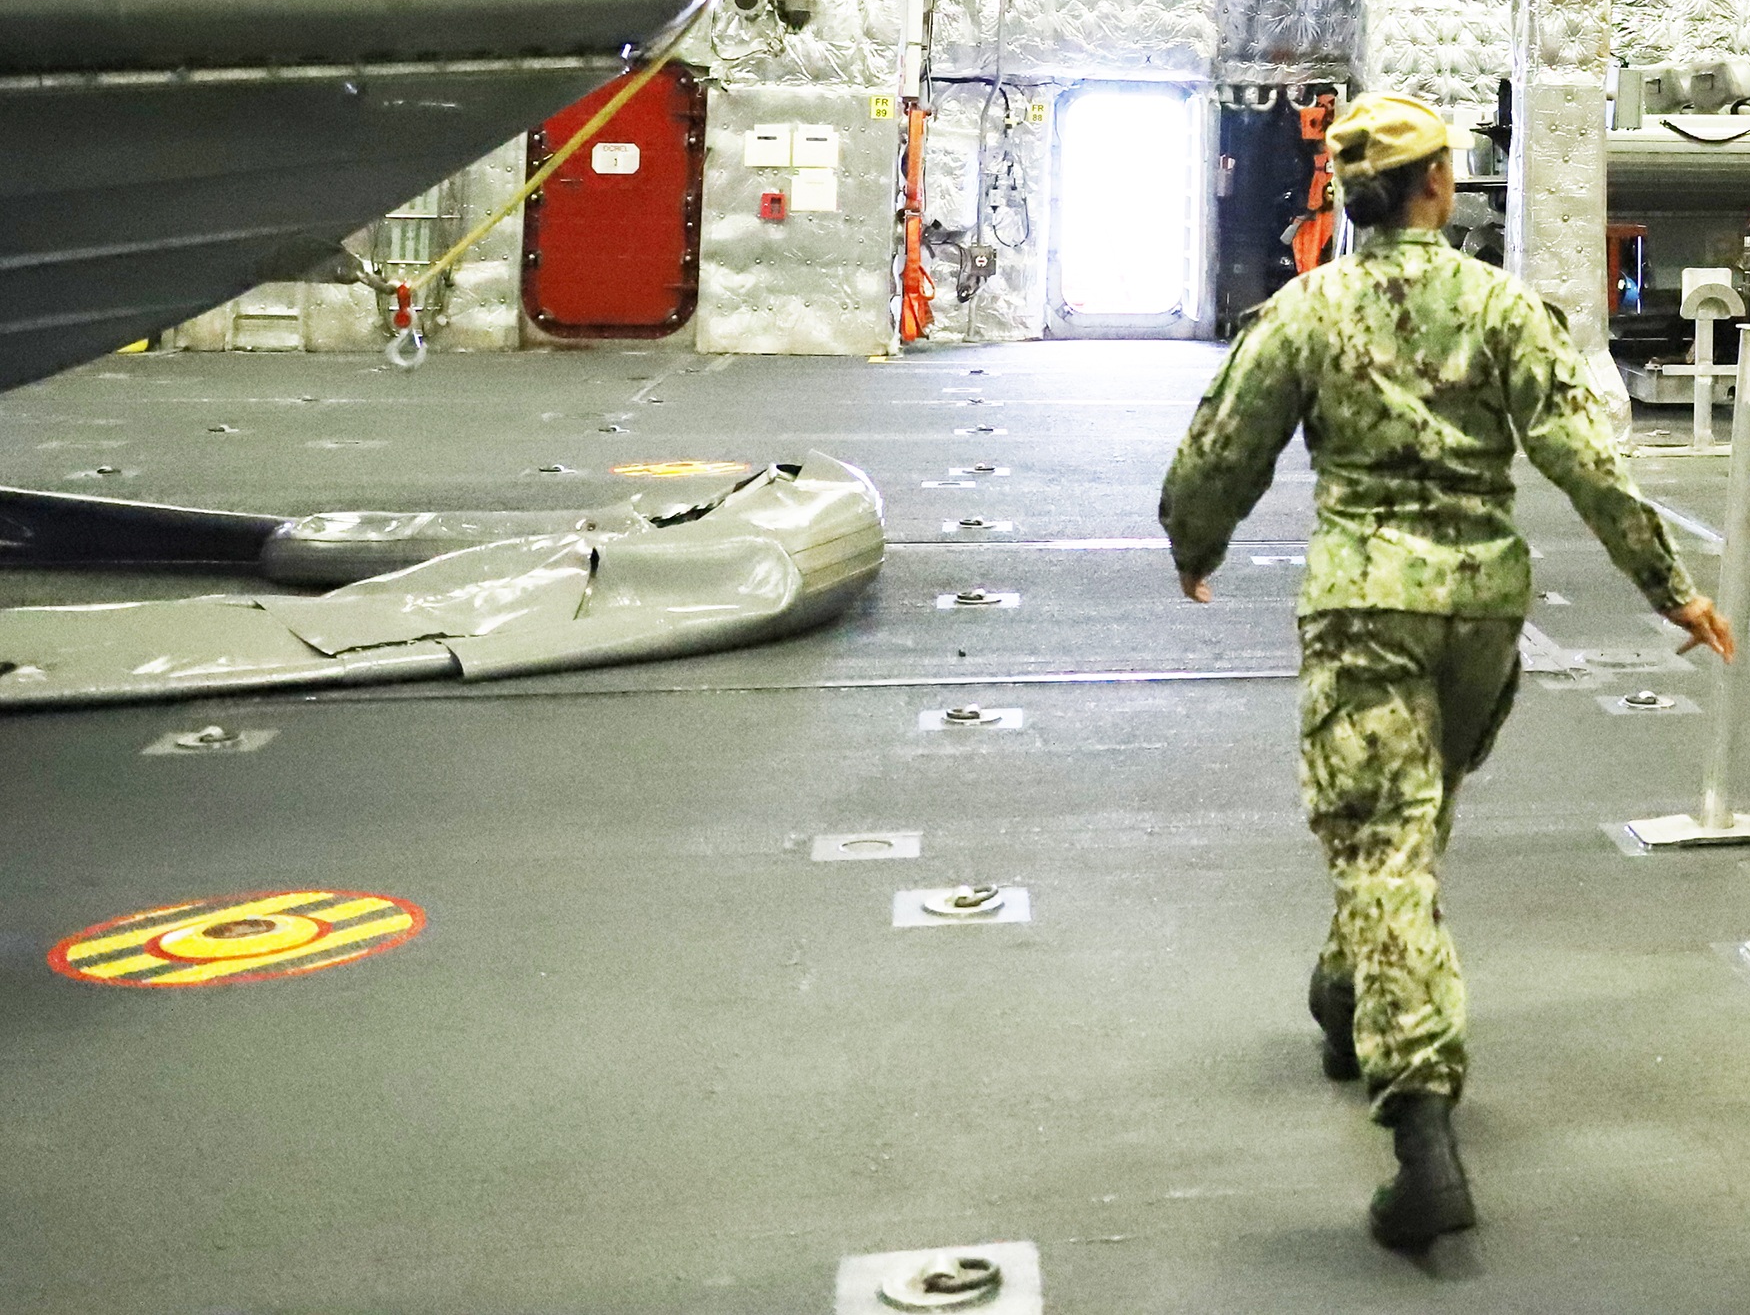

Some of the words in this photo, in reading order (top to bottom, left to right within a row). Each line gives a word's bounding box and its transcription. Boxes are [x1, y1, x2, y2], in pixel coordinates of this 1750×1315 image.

[875, 98, 889, 107] FR
[1031, 104, 1044, 112] FR
[875, 109, 887, 117] 89
[1032, 114, 1043, 122] 88
